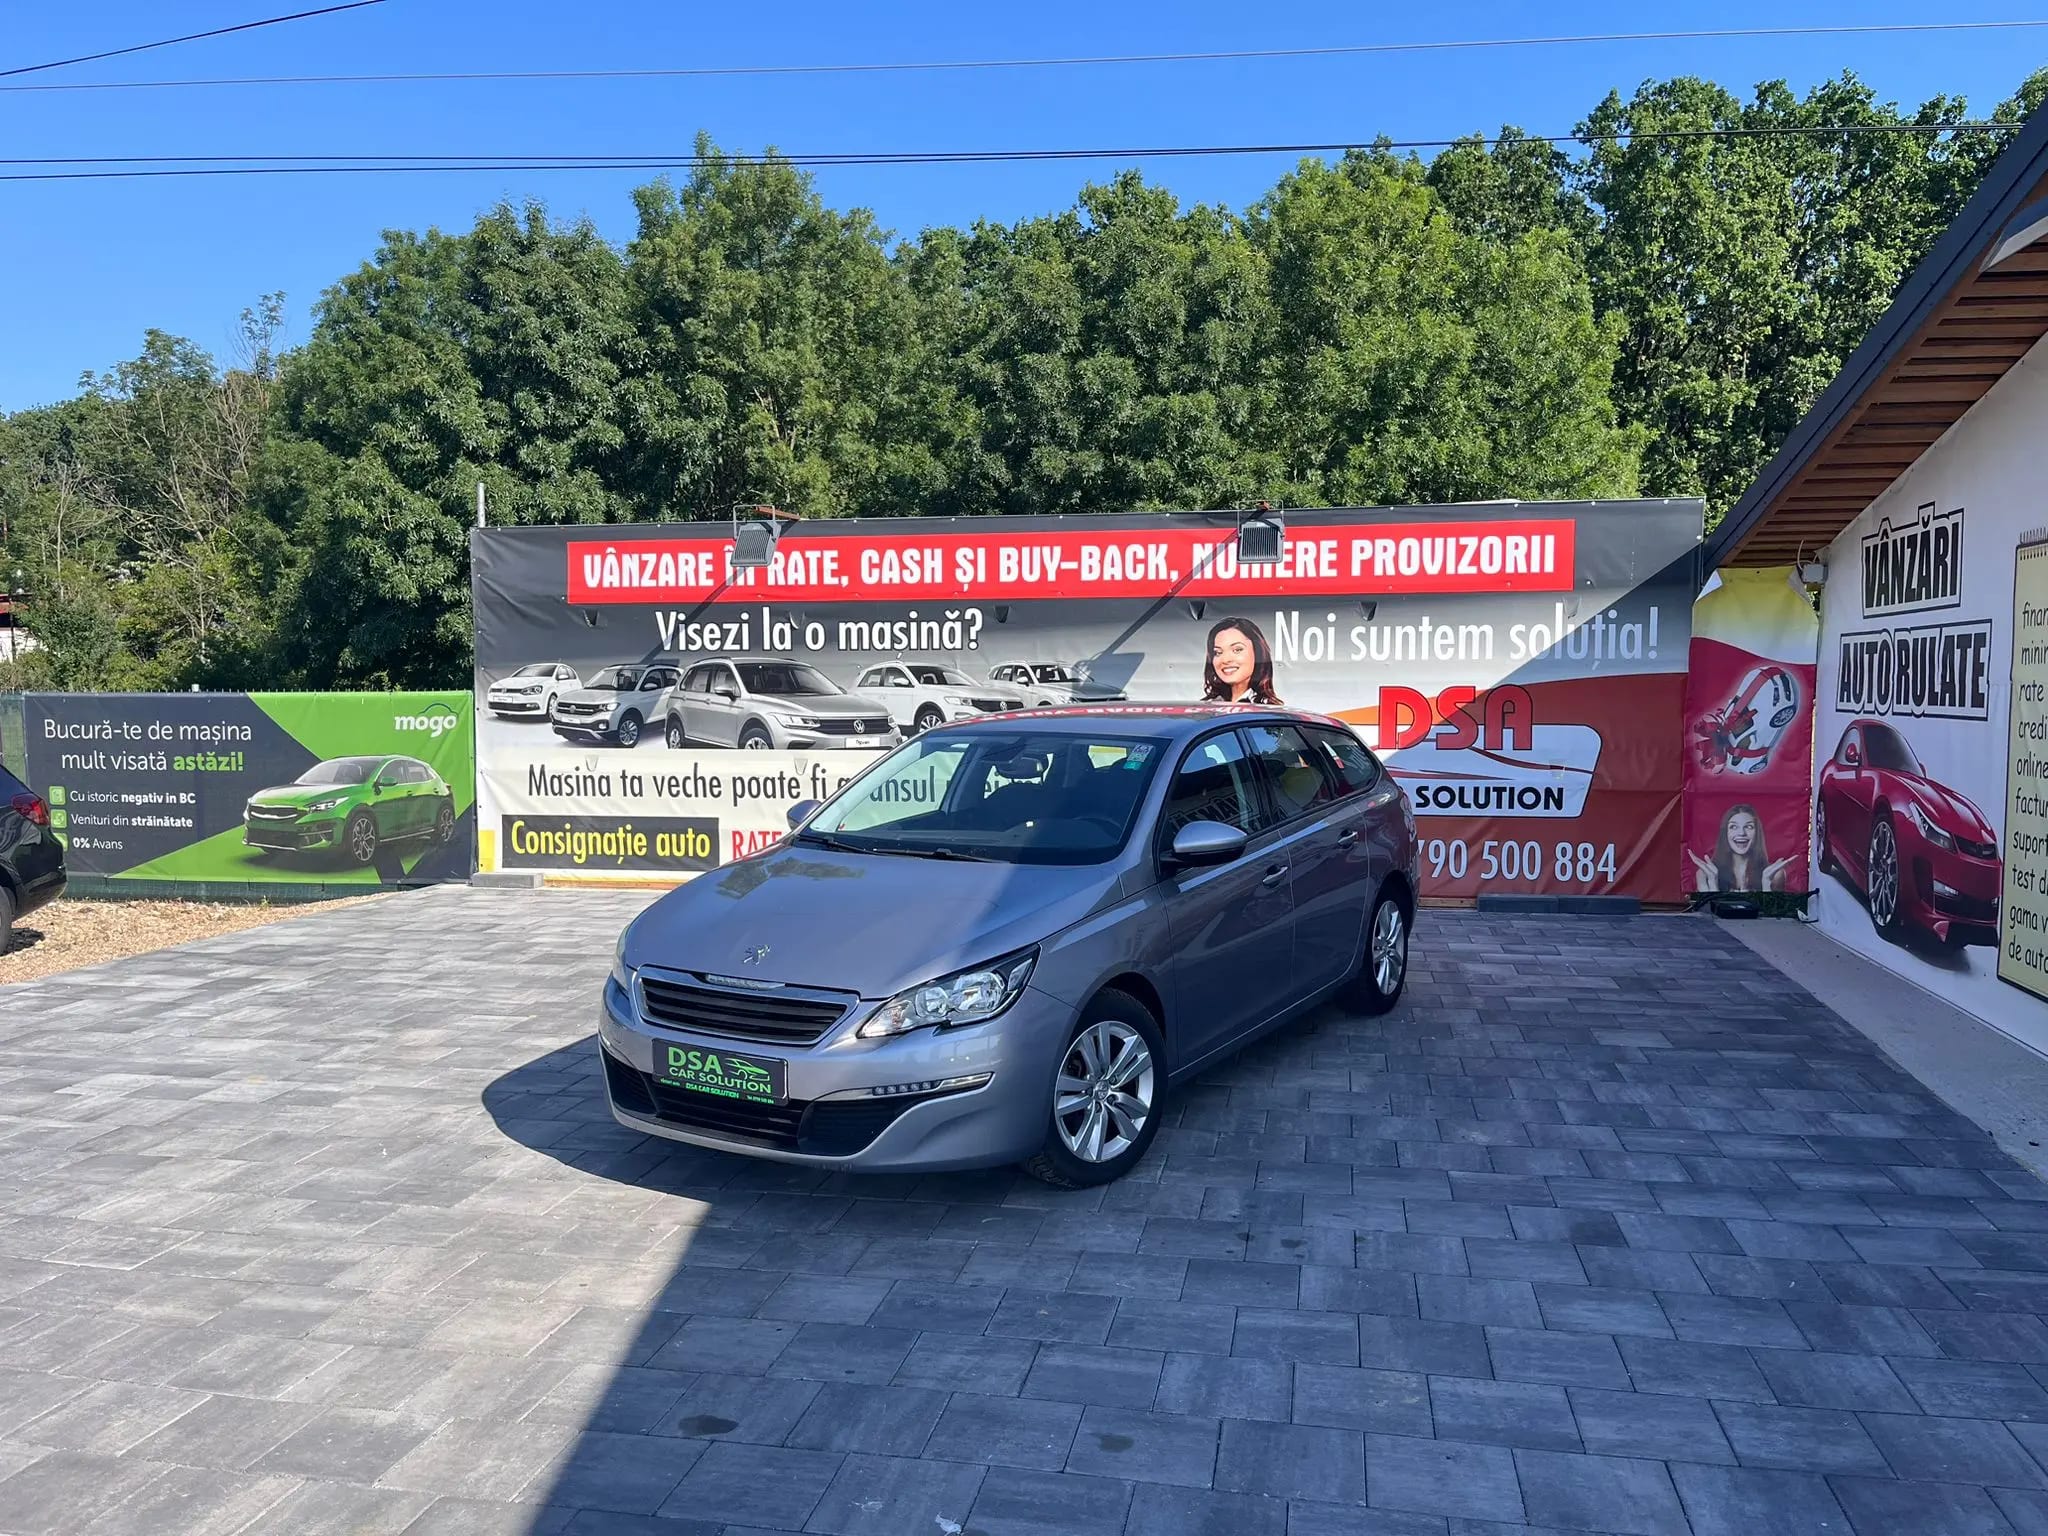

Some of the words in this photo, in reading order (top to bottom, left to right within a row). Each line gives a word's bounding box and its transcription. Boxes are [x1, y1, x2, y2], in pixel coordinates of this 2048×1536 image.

[583, 546, 714, 588] VÂNZARE
[767, 549, 849, 588] RATE,
[860, 548, 943, 585] CASH
[955, 547, 986, 592] ȘI
[999, 543, 1179, 583] BUY-BACK,
[1350, 534, 1555, 576] PROVIZORII
[1864, 514, 1960, 608] VÂNZĂRI
[655, 611, 750, 651] Visezi
[762, 606, 793, 651] la
[804, 621, 826, 651] o
[1274, 610, 1336, 662] Noi
[1350, 615, 1494, 662] suntem
[1509, 601, 1659, 670] soluția!
[1839, 638, 1893, 706] AUTO
[1895, 631, 1987, 709] RULATE
[2019, 680, 2044, 702] rate
[394, 715, 457, 738] mogo
[1379, 684, 1533, 750] DSA
[44, 719, 141, 741] Bucură-te
[148, 721, 173, 741] de
[179, 721, 252, 745] mașina
[62, 750, 106, 770] mult
[112, 751, 167, 771] visată
[173, 751, 244, 772] astăzi!
[2016, 751, 2048, 780] online
[620, 769, 644, 797] ta
[653, 762, 722, 798] veche
[732, 771, 801, 804] poate
[811, 763, 827, 799] fi
[70, 791, 85, 802] Cu
[87, 790, 118, 803] istoric
[121, 793, 163, 805] negativ
[179, 792, 196, 804] BC
[1415, 785, 1564, 811] SOLUTION
[71, 814, 110, 826] Venituri
[112, 815, 129, 826] din
[131, 815, 193, 828] străinătate
[73, 837, 90, 848] 0%
[93, 838, 123, 850] Avans
[511, 820, 648, 865] Consignație
[656, 831, 710, 858] auto
[1480, 840, 1542, 880] 500
[1554, 842, 1617, 883] 884
[2012, 864, 2035, 891] test
[2009, 905, 2038, 931] gama
[2008, 935, 2022, 962] de
[668, 1047, 723, 1075] DSA
[669, 1067, 695, 1080] CAR
[699, 1072, 772, 1094] SOLUTION
